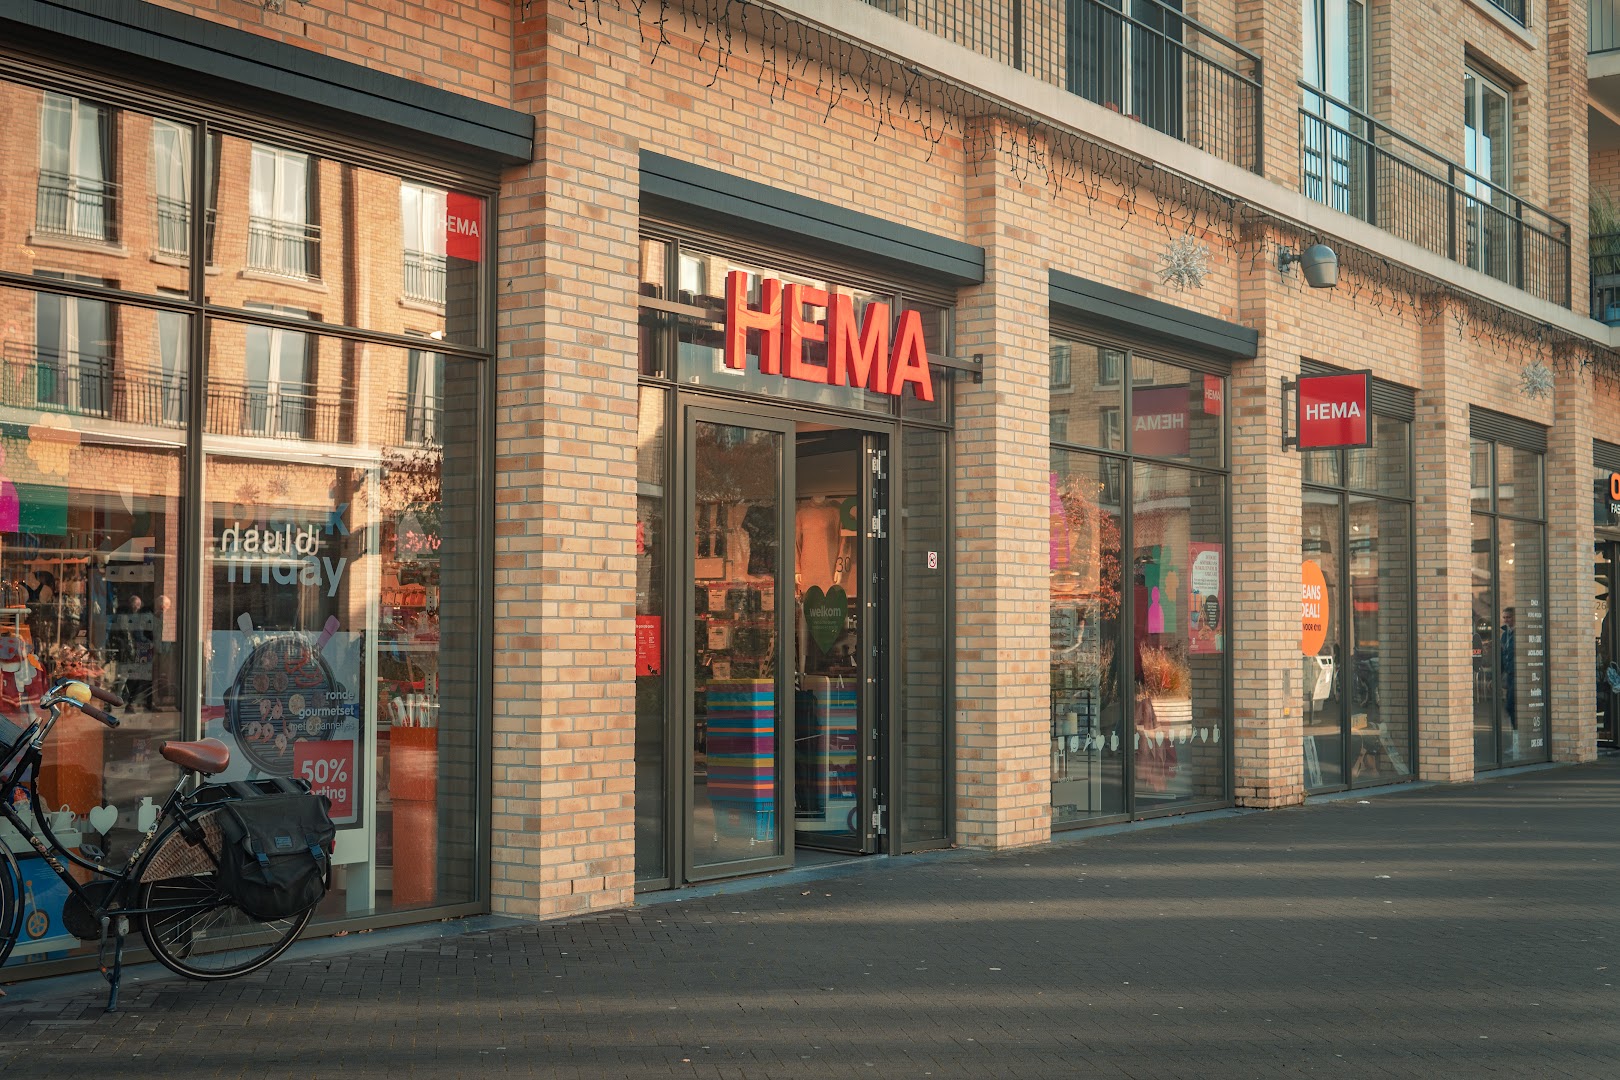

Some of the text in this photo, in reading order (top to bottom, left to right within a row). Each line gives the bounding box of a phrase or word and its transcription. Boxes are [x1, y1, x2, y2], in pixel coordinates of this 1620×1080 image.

[725, 270, 934, 401] HEMA
[1205, 389, 1221, 401] HEMA
[1306, 402, 1361, 420] HEMA
[836, 557, 851, 572] 30
[1302, 584, 1321, 600] EANS
[809, 604, 842, 617] welkom
[325, 691, 354, 700] ronde
[298, 705, 355, 719] gourmetset
[290, 721, 306, 731] met
[301, 758, 348, 783] 50%
[310, 786, 347, 803] rting
